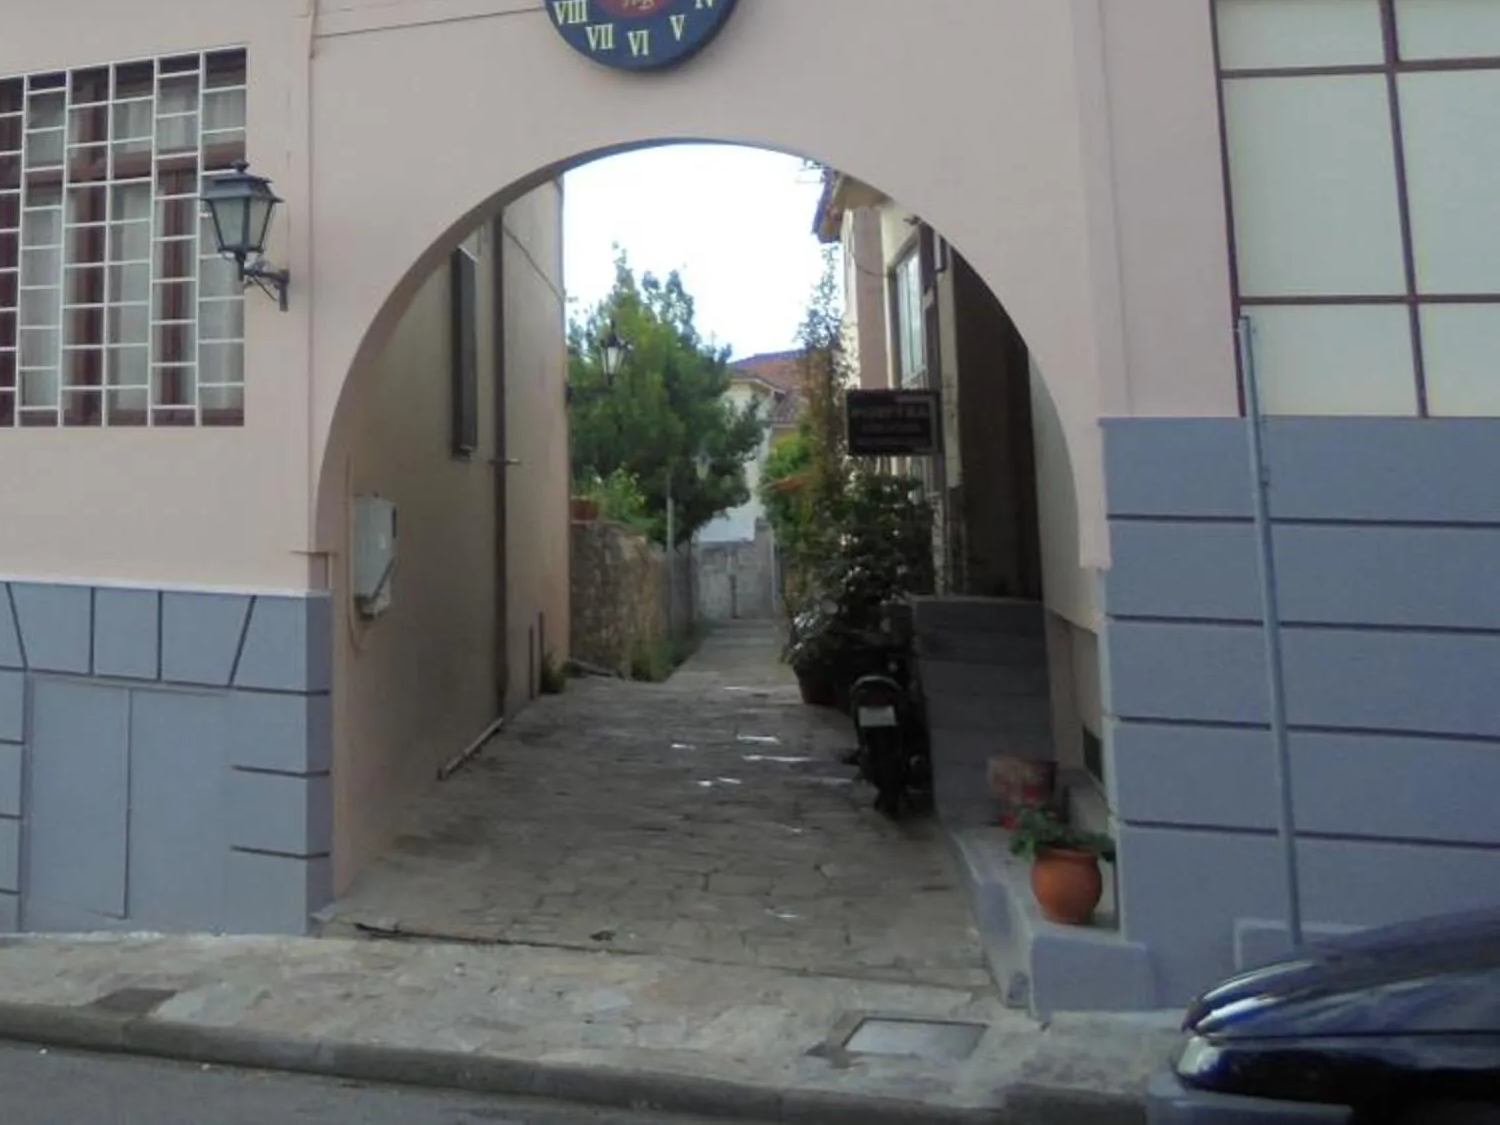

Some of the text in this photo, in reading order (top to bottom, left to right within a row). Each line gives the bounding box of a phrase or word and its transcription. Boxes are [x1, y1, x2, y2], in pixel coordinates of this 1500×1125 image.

[585, 24, 613, 51] VII
[670, 14, 685, 41] V
[627, 30, 649, 56] VI
